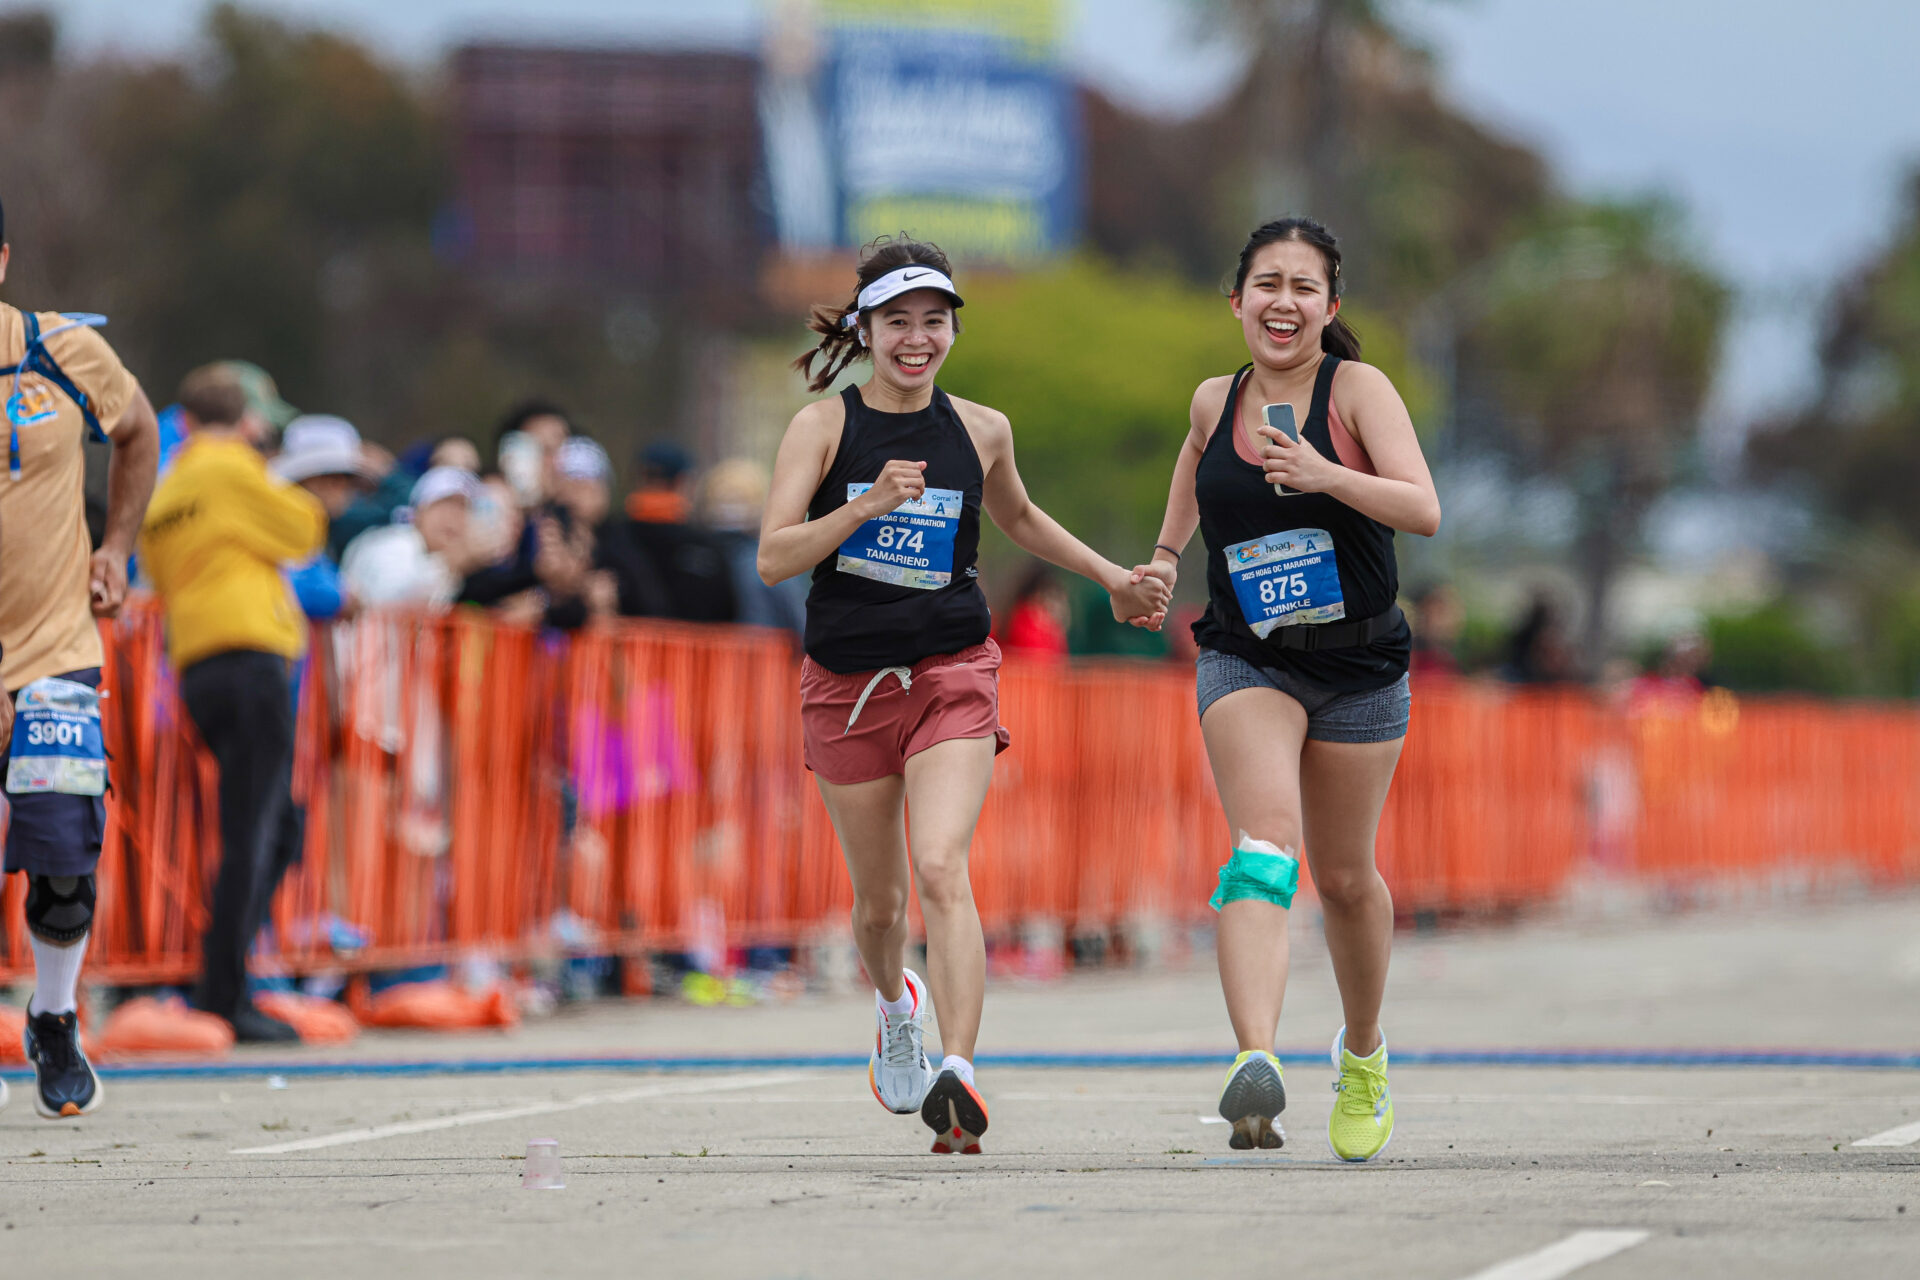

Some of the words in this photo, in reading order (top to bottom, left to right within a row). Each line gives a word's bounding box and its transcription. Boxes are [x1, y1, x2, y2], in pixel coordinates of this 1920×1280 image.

[931, 494, 952, 502] Corral
[935, 502, 945, 515] A
[879, 514, 898, 523] HOAG
[909, 517, 946, 528] MARATHON
[877, 525, 924, 553] 874
[1298, 532, 1319, 540] Corral
[1306, 539, 1317, 552] A
[865, 547, 930, 567] TAMARIEND
[1241, 571, 1255, 581] 2025
[1255, 567, 1272, 578] HOAG
[1272, 564, 1283, 574] OC
[1283, 556, 1322, 571] MARATHON
[1259, 572, 1308, 604] 875
[1262, 598, 1312, 617] TWINKLE
[27, 720, 83, 746] 3901
